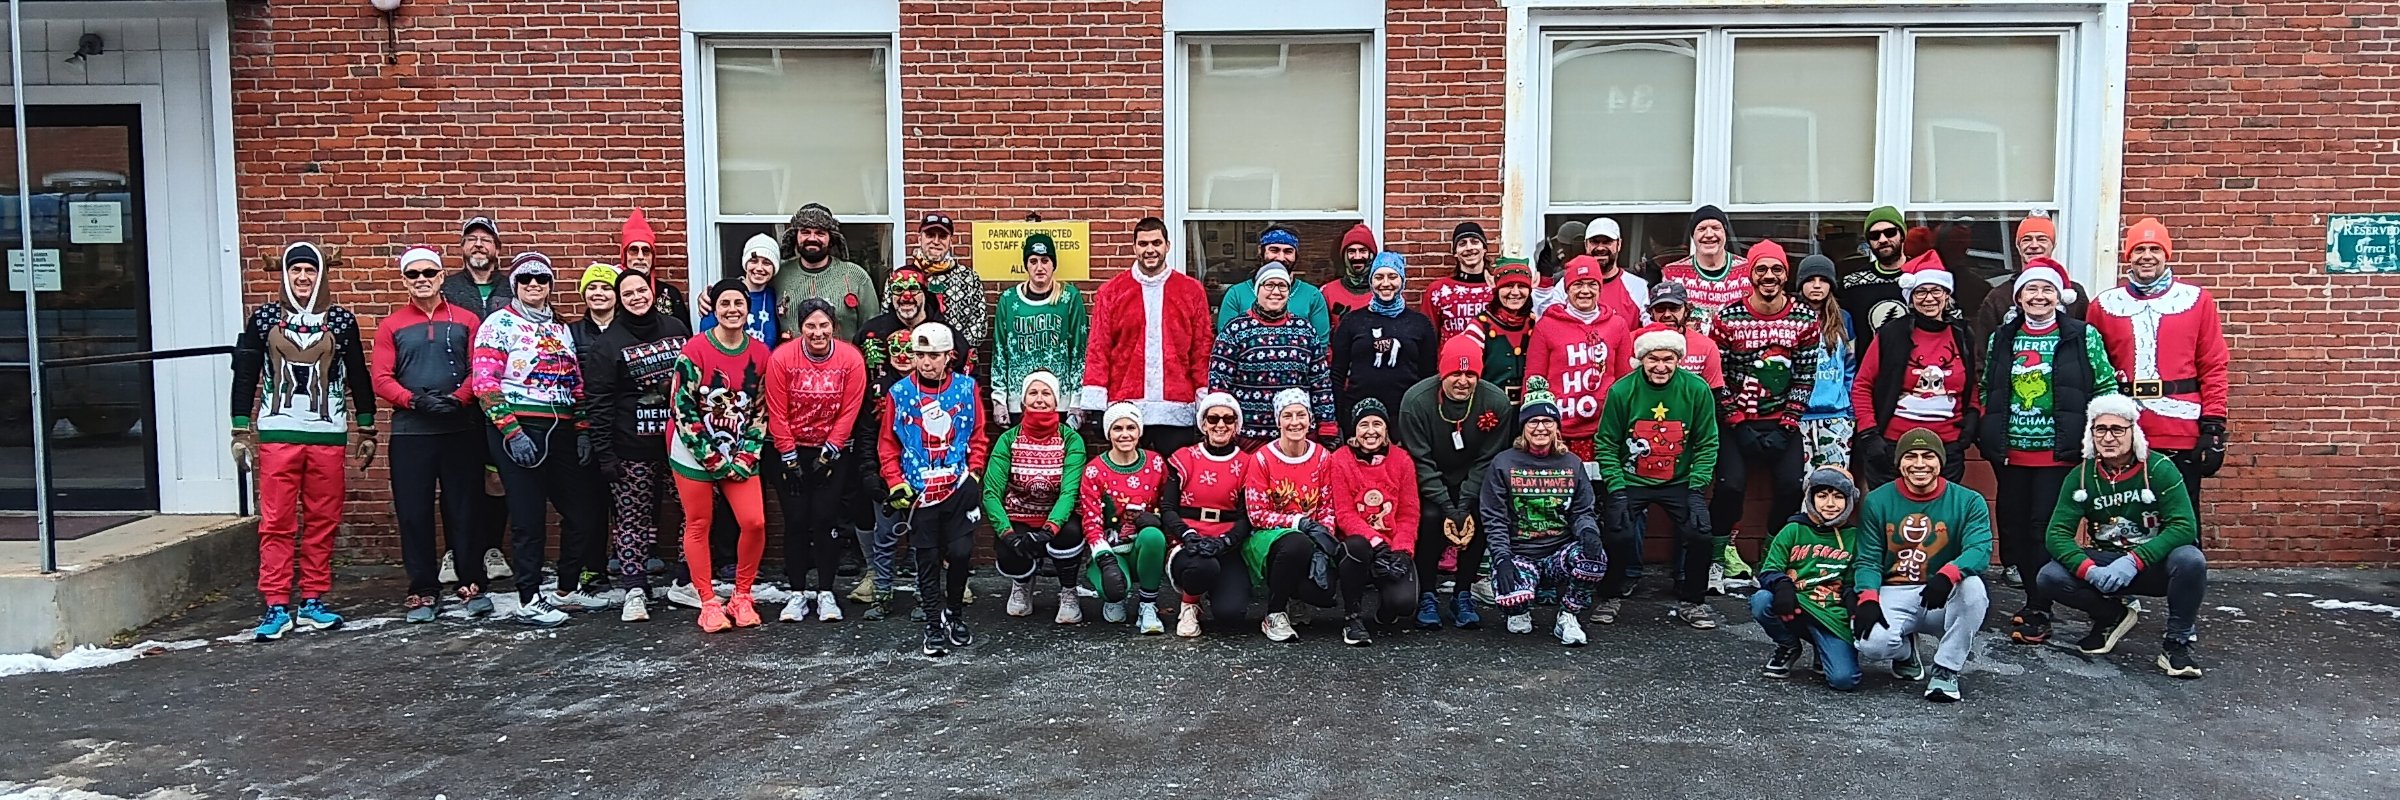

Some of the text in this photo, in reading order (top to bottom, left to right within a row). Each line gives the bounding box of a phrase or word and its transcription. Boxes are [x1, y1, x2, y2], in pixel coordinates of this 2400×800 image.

[988, 229, 1022, 238] PARKING
[982, 241, 992, 250] TO
[994, 241, 1019, 250] STAFF
[1457, 302, 1489, 317] MER
[1013, 313, 1062, 335] JINGLE
[1760, 329, 1767, 339] A
[1769, 328, 1797, 340] MERR
[1018, 331, 1060, 352] BELLS
[2013, 339, 2059, 351] MERRY
[642, 355, 657, 365] YOU
[1685, 355, 1707, 363] JOLLY
[1556, 395, 1598, 418] HO
[636, 408, 659, 419] ONE
[1511, 477, 1575, 488] RELAX I HAVE A
